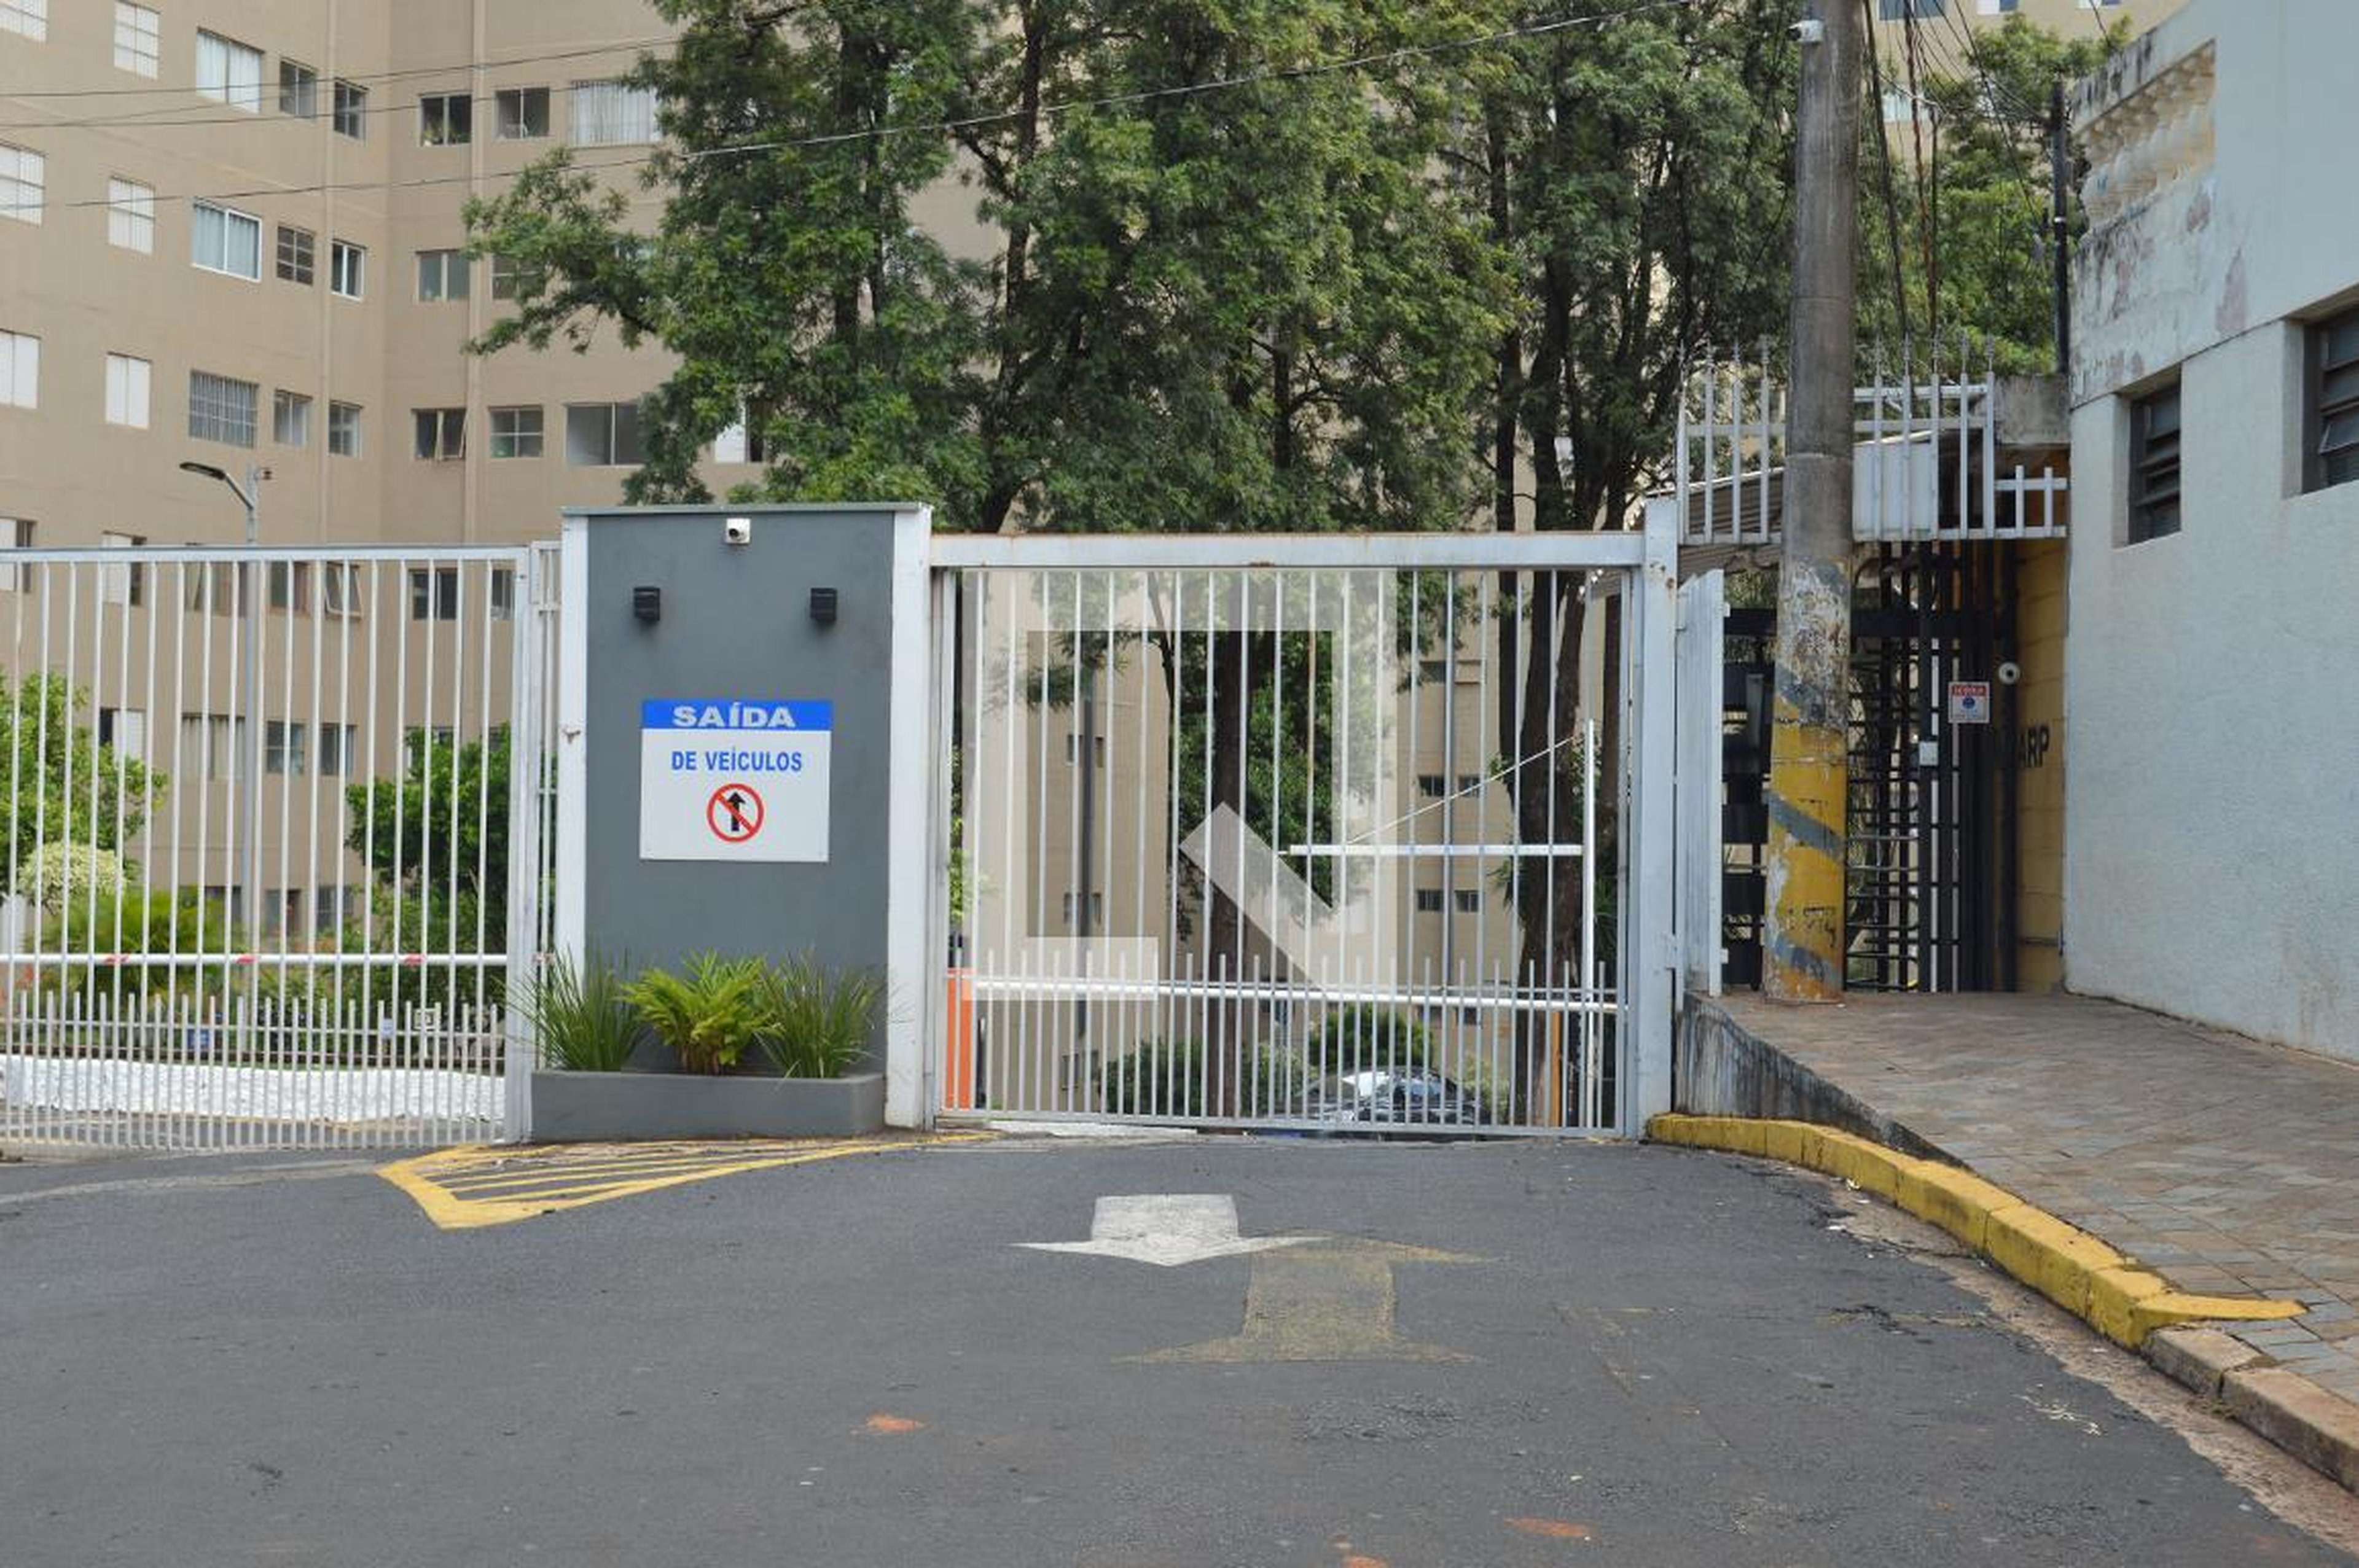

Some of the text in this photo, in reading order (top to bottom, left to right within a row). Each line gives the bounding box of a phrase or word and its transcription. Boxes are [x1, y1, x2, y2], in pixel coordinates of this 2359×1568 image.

[672, 701, 796, 728] SAÍDA
[671, 746, 802, 771] DE VEÍCULOS
